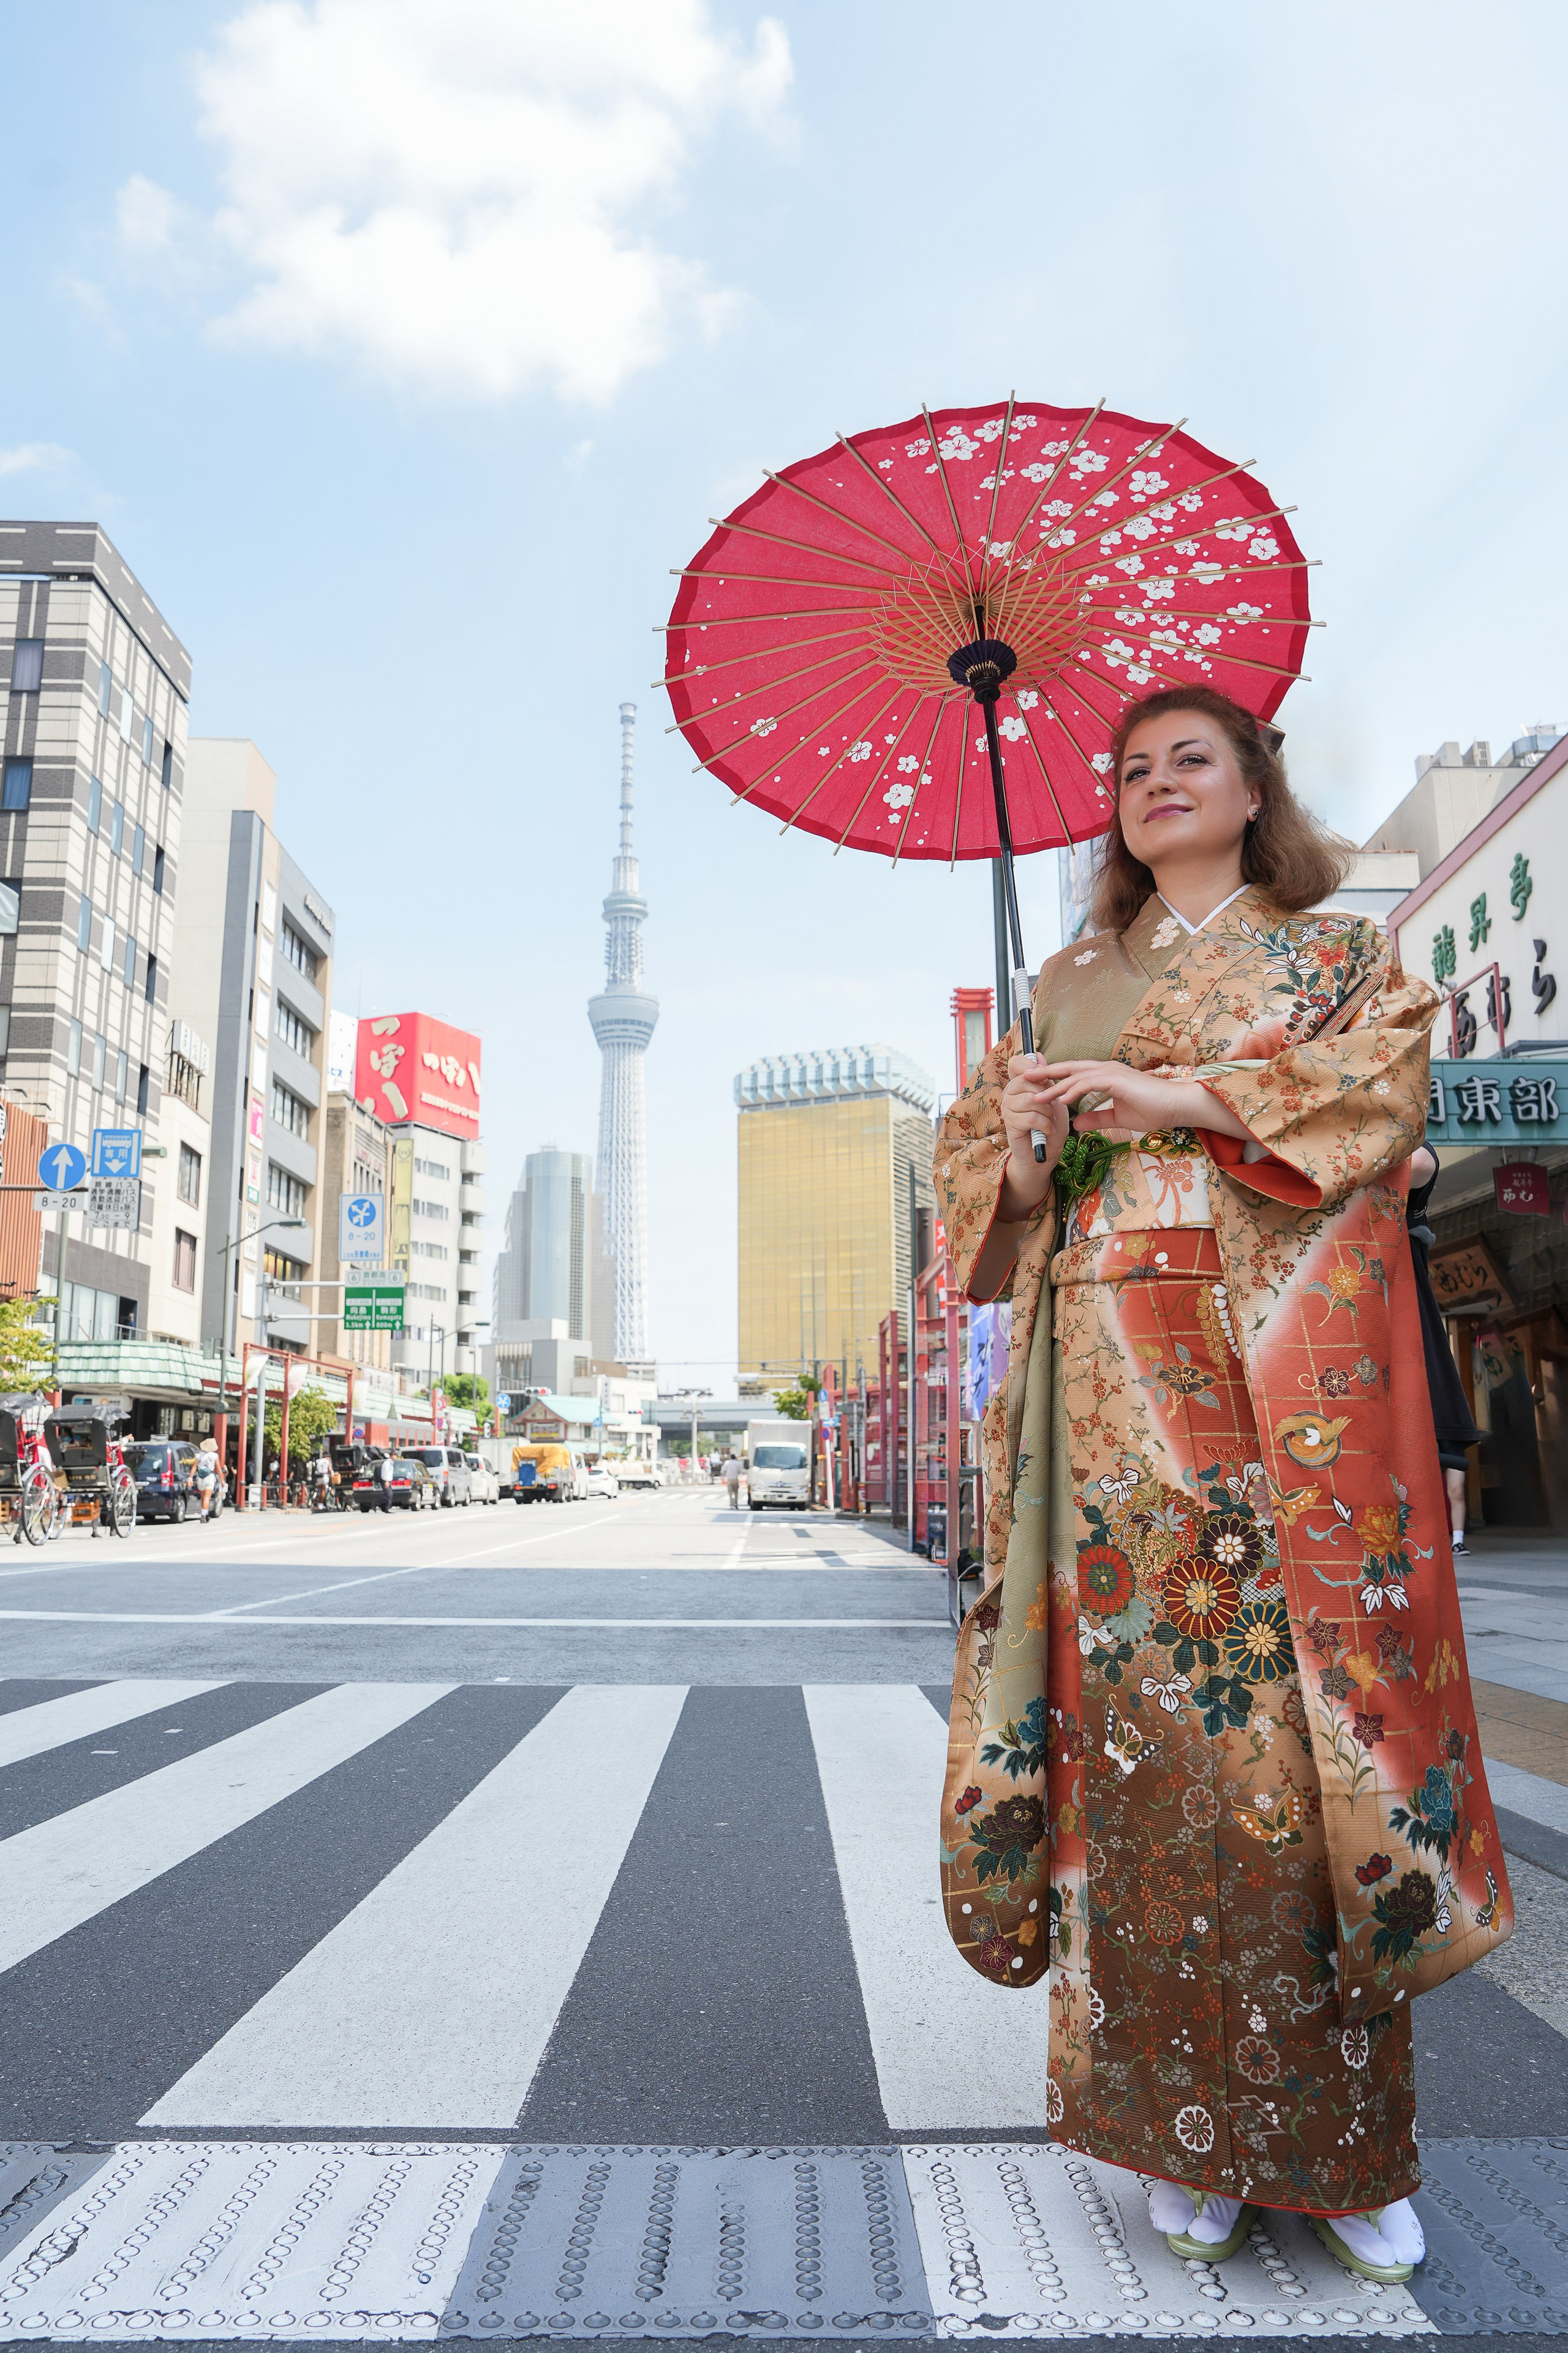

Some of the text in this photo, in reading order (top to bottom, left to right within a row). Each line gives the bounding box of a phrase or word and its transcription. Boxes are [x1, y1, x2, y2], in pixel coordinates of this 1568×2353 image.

[363, 1016, 409, 1120] つぼ八
[423, 1052, 481, 1096] つぼ八
